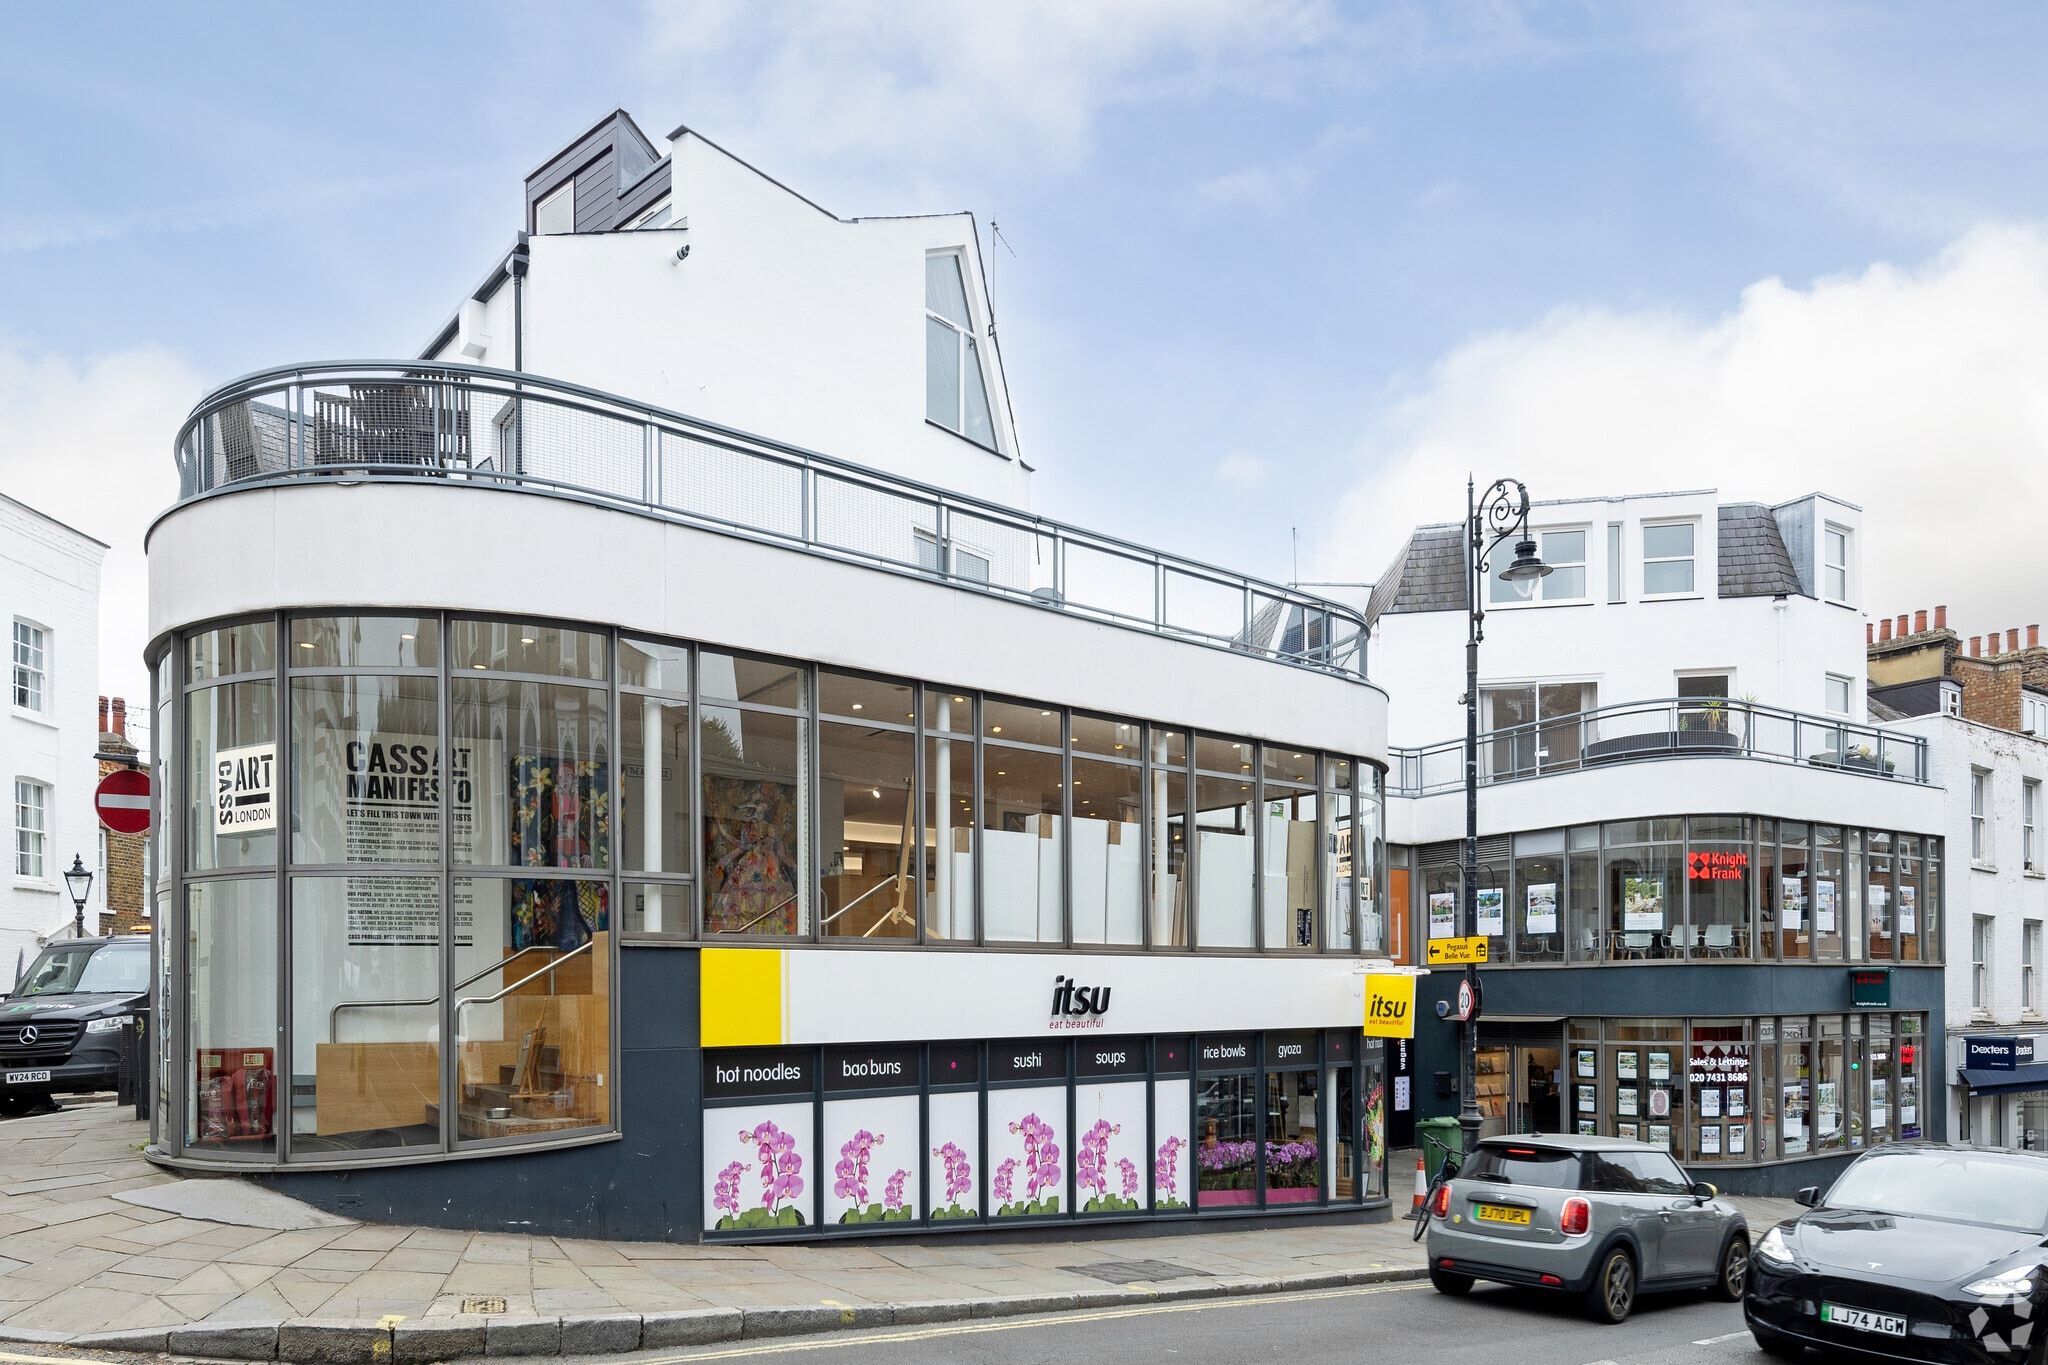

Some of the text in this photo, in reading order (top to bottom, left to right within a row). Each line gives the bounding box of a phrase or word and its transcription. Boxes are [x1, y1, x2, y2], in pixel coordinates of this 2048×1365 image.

[346, 741, 428, 775] CASS
[235, 754, 273, 791] ART
[219, 760, 233, 825] CASS
[346, 774, 472, 803] MANIFESO
[235, 807, 271, 823] LONDON
[346, 809, 365, 818] LET'S
[367, 810, 381, 818] FILL
[382, 811, 399, 819] THIS
[400, 811, 421, 820] TOWN
[1712, 852, 1747, 868] Knight
[1712, 867, 1742, 879] Frank
[1446, 944, 1468, 952] Pegasus
[1051, 975, 1112, 1016] itsu
[1460, 993, 1469, 1008] 20
[1369, 994, 1407, 1018] itsu
[1049, 1018, 1104, 1029] eat beautiful
[1366, 1037, 1375, 1049] hot
[1971, 1044, 2009, 1054] Dexters
[2015, 1046, 2033, 1055] Dexters
[1095, 1050, 1126, 1066] soups
[1203, 1044, 1246, 1059] rice bowls
[1278, 1044, 1302, 1058] gyoza
[843, 1058, 901, 1077] bao buns
[1013, 1053, 1042, 1068] sushi
[1689, 1057, 1748, 1068] Sales & Lettings
[9, 1071, 47, 1082] WV24 RCO
[716, 1062, 801, 1083] hot noodles
[1689, 1073, 1748, 1082] 020 7431 8686
[1831, 1307, 1906, 1334] LJ74 AGW
